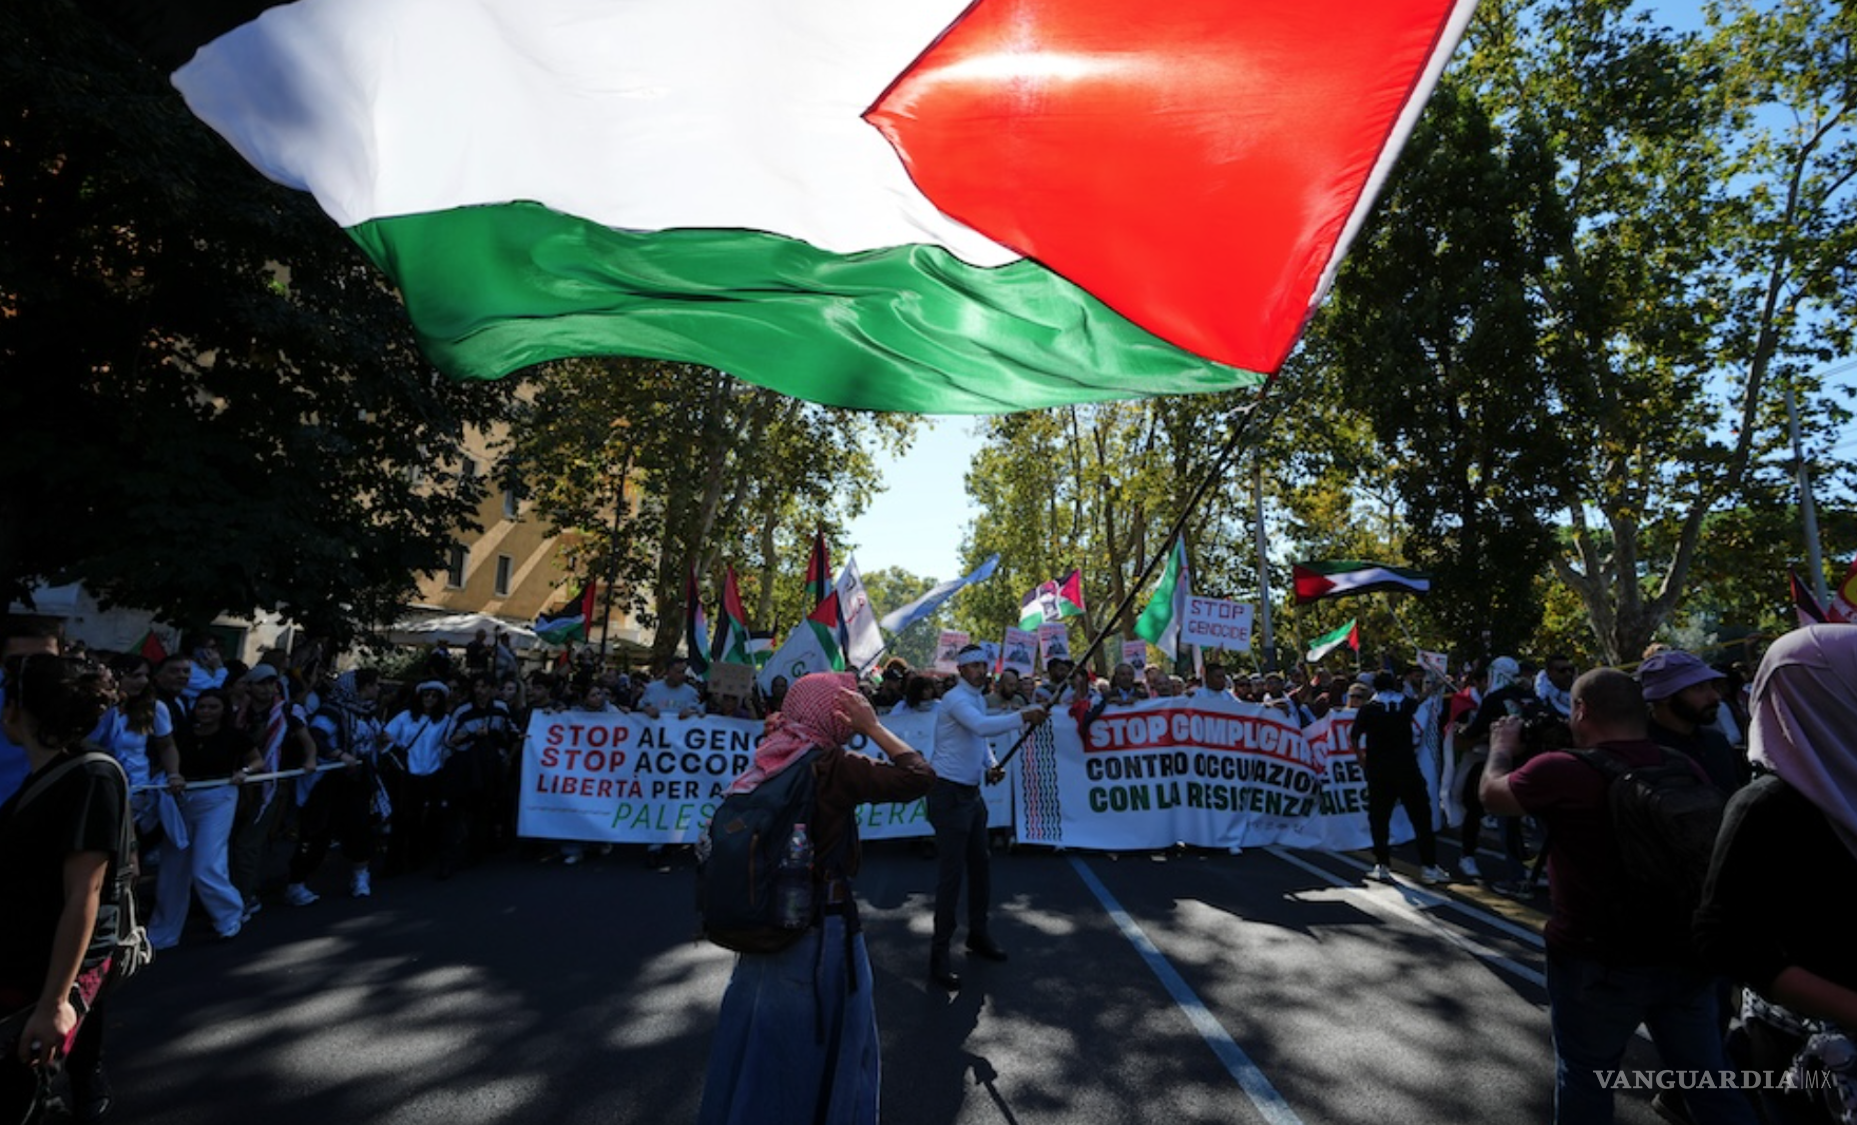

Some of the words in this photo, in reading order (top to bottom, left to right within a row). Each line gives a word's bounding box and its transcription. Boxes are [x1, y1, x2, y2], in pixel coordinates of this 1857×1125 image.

[1191, 599, 1244, 619] STOP
[1188, 620, 1248, 641] GENOCIDE
[546, 724, 629, 748] STOP
[637, 727, 672, 748] AL
[1089, 715, 1168, 748] STOP
[540, 748, 626, 772] STOP
[634, 752, 749, 775] ACCOR
[1086, 752, 1188, 780] CONTRO
[651, 780, 699, 799] PER
[1089, 785, 1150, 813] CON
[1156, 782, 1181, 809] LA
[611, 803, 717, 830] PALES
